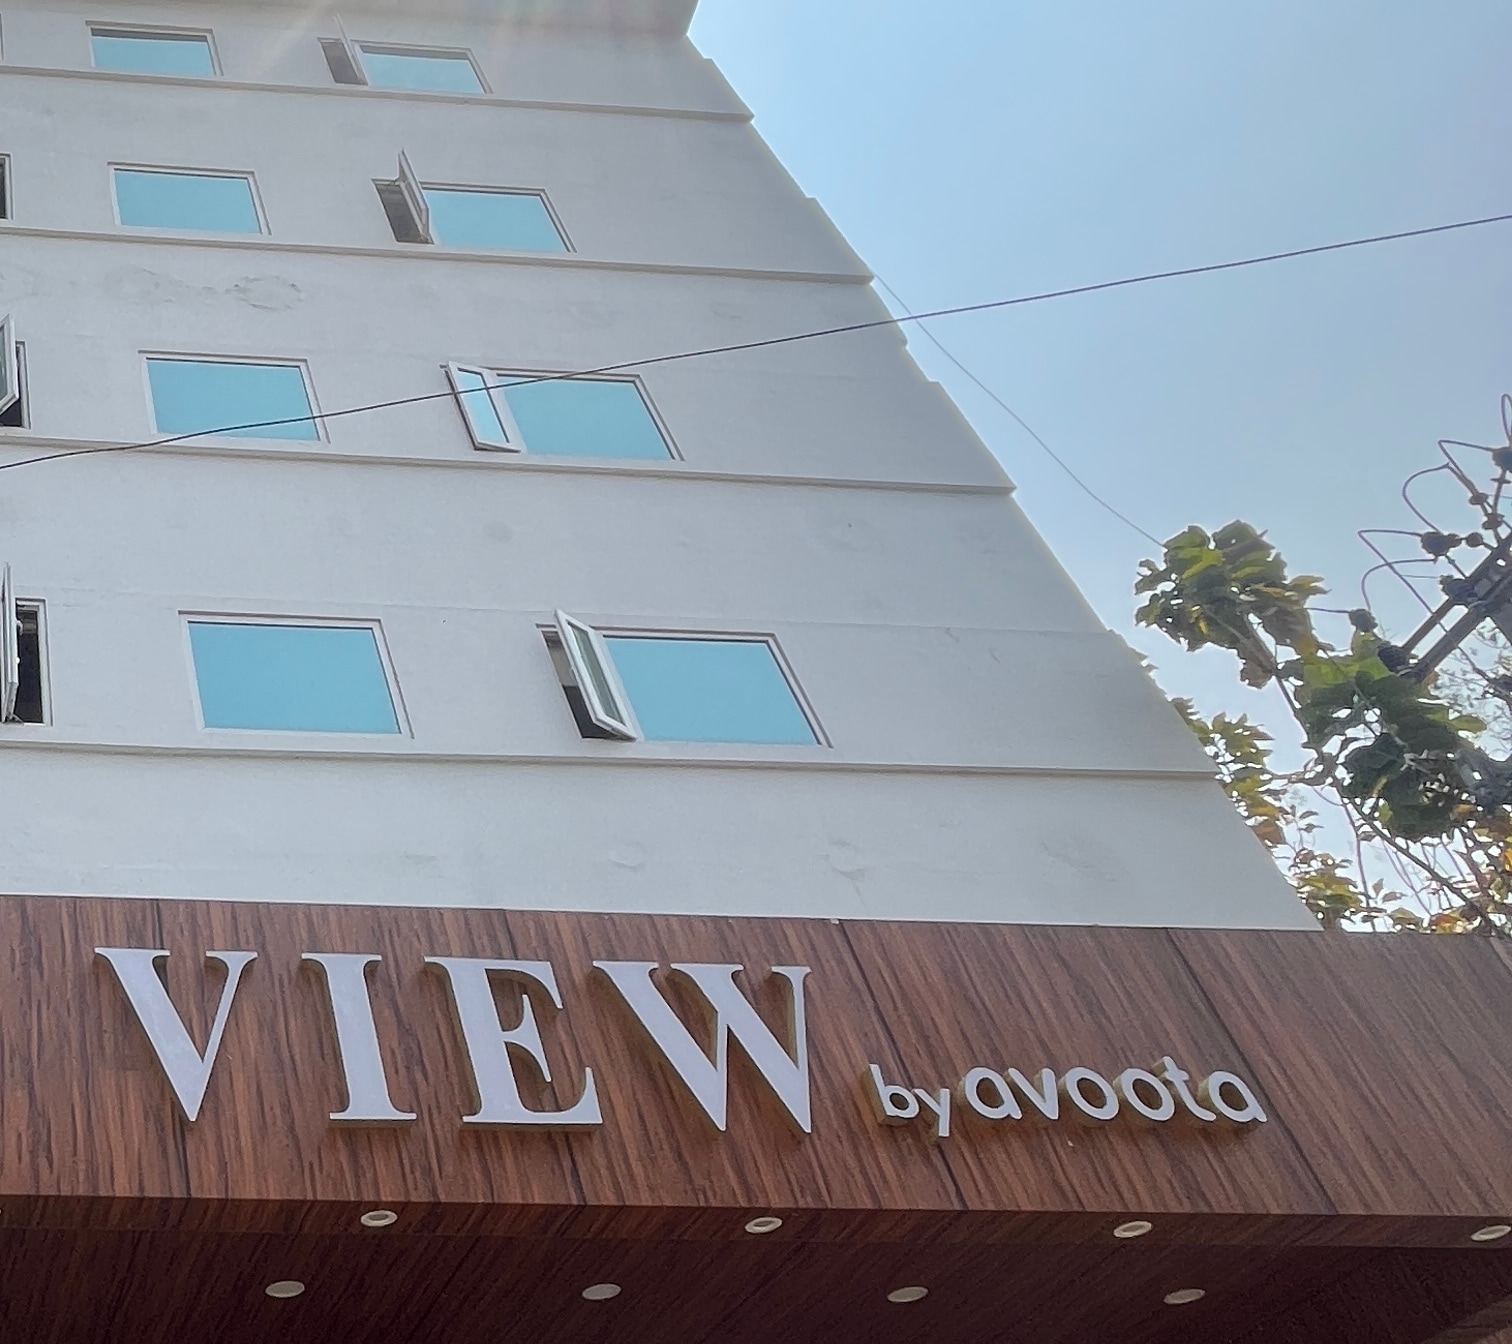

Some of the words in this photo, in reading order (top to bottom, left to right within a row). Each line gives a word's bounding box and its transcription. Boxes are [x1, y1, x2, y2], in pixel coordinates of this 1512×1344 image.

[93, 946, 814, 1134] VIEW
[866, 1062, 951, 1138] by
[962, 1055, 1268, 1123] avoota
